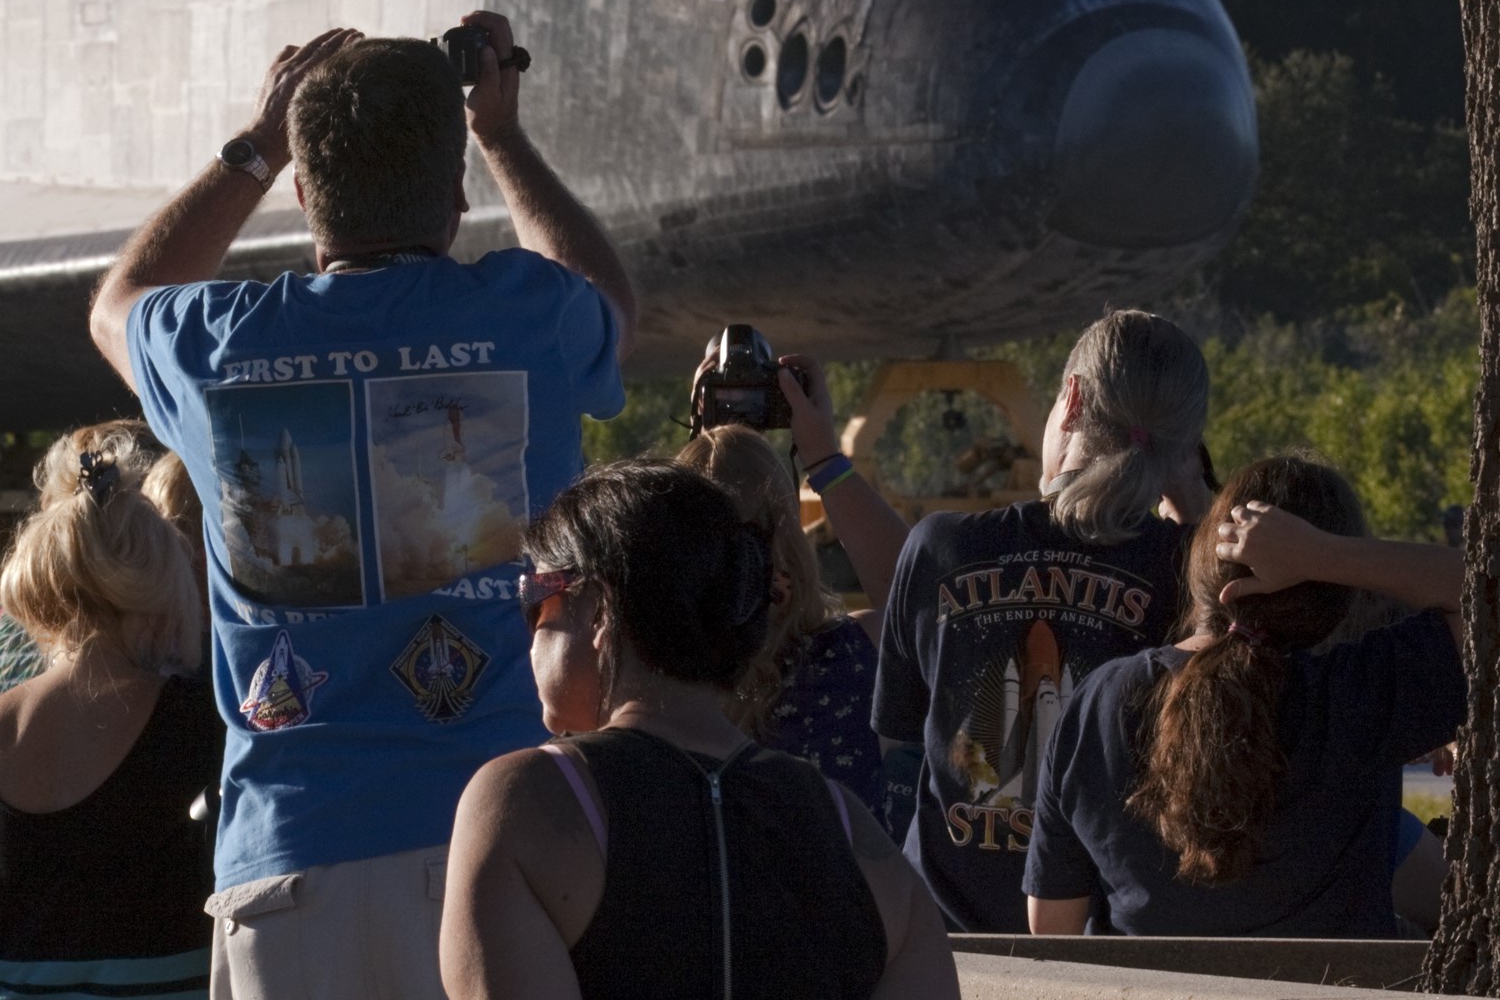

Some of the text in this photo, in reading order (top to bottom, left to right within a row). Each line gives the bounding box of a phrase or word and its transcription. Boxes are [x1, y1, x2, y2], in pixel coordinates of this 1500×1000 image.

[222, 341, 496, 384] FIRST TO LAST
[998, 550, 1041, 566] SPACE
[936, 565, 1152, 627] ATLANTIS
[974, 609, 1104, 631] THE END OF AN ERA
